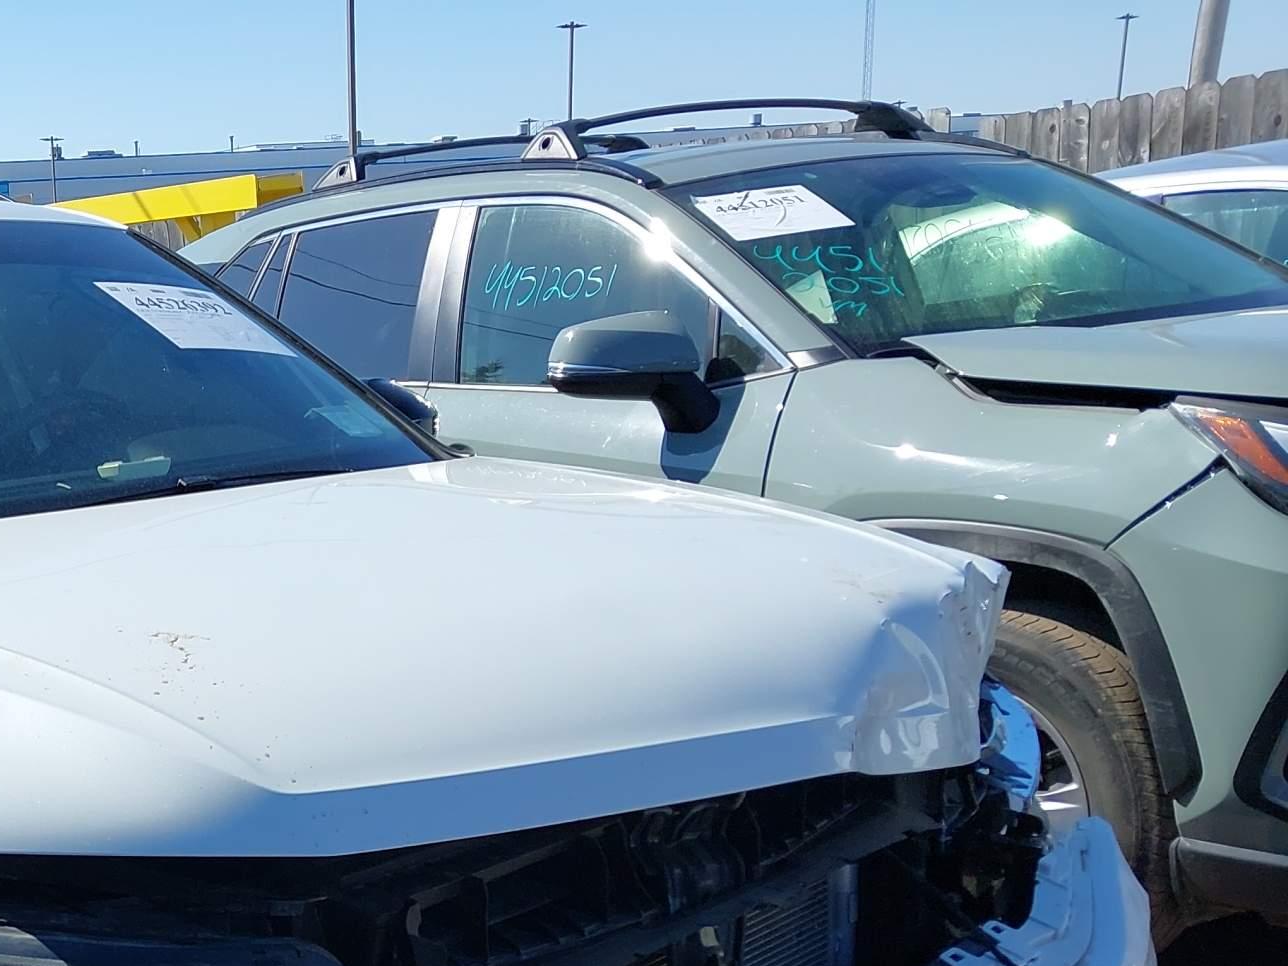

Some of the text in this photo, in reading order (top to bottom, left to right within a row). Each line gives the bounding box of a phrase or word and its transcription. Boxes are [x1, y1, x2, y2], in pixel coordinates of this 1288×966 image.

[753, 245, 884, 273] 4451
[485, 259, 618, 311] 44512051
[134, 296, 233, 316] 44526392
